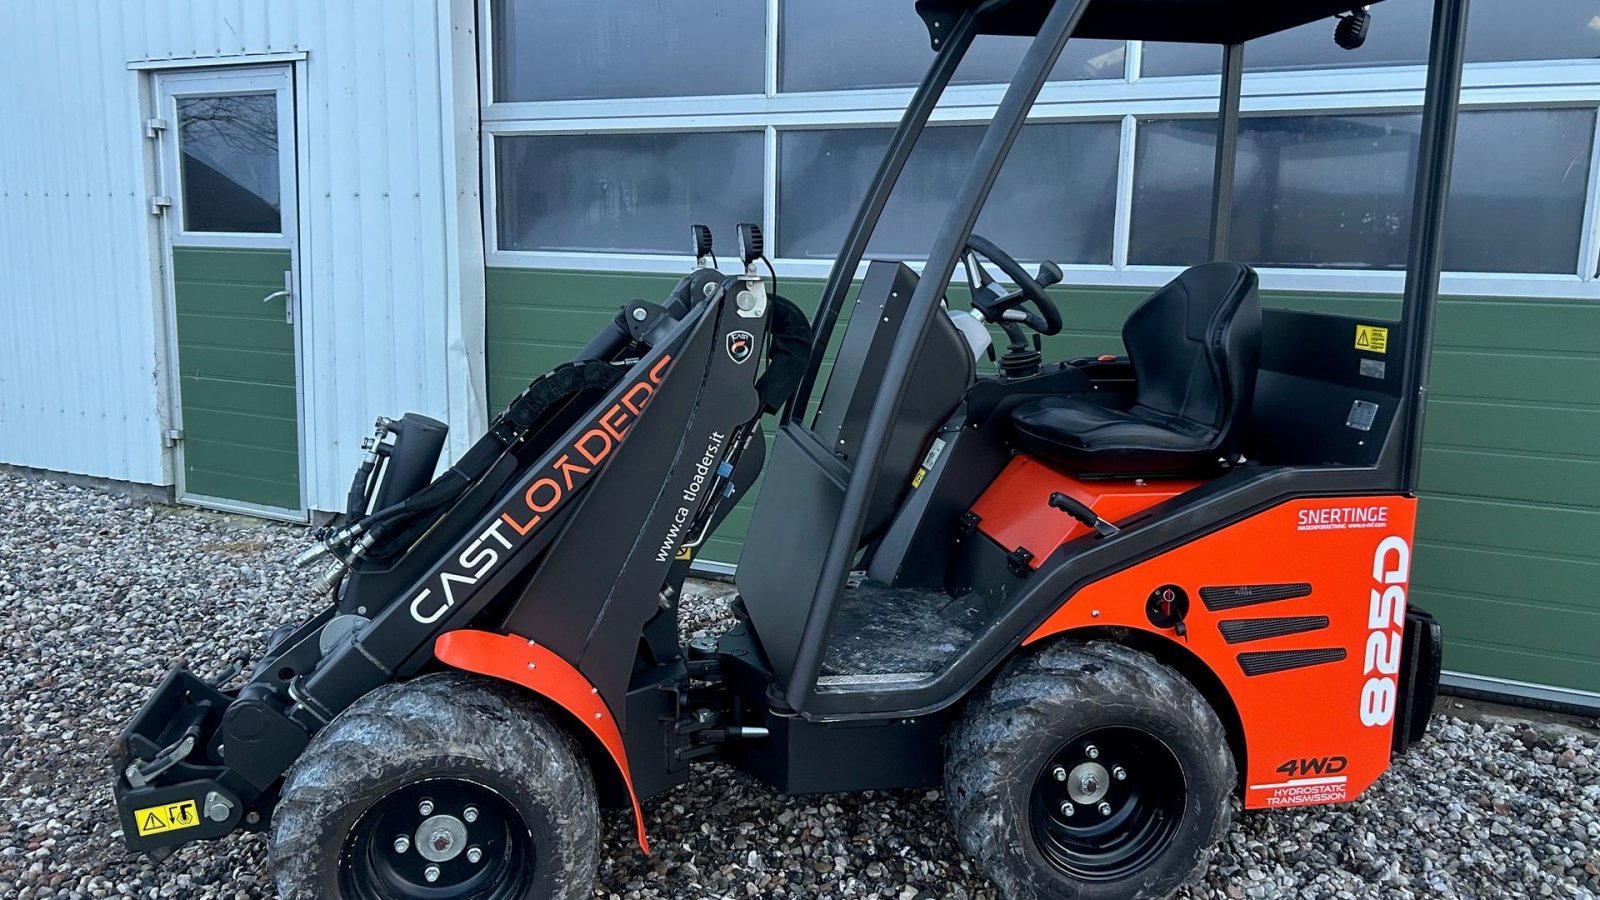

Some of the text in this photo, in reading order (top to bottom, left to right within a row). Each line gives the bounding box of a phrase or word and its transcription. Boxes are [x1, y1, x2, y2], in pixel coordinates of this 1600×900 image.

[732, 333, 749, 341] CAST
[1298, 506, 1388, 525] SNERTINGE
[1359, 535, 1410, 727] 825D
[1276, 756, 1348, 777] 4WD
[1266, 791, 1346, 806] TRANSMISSION
[1274, 783, 1346, 797] HYDROSTATIC
